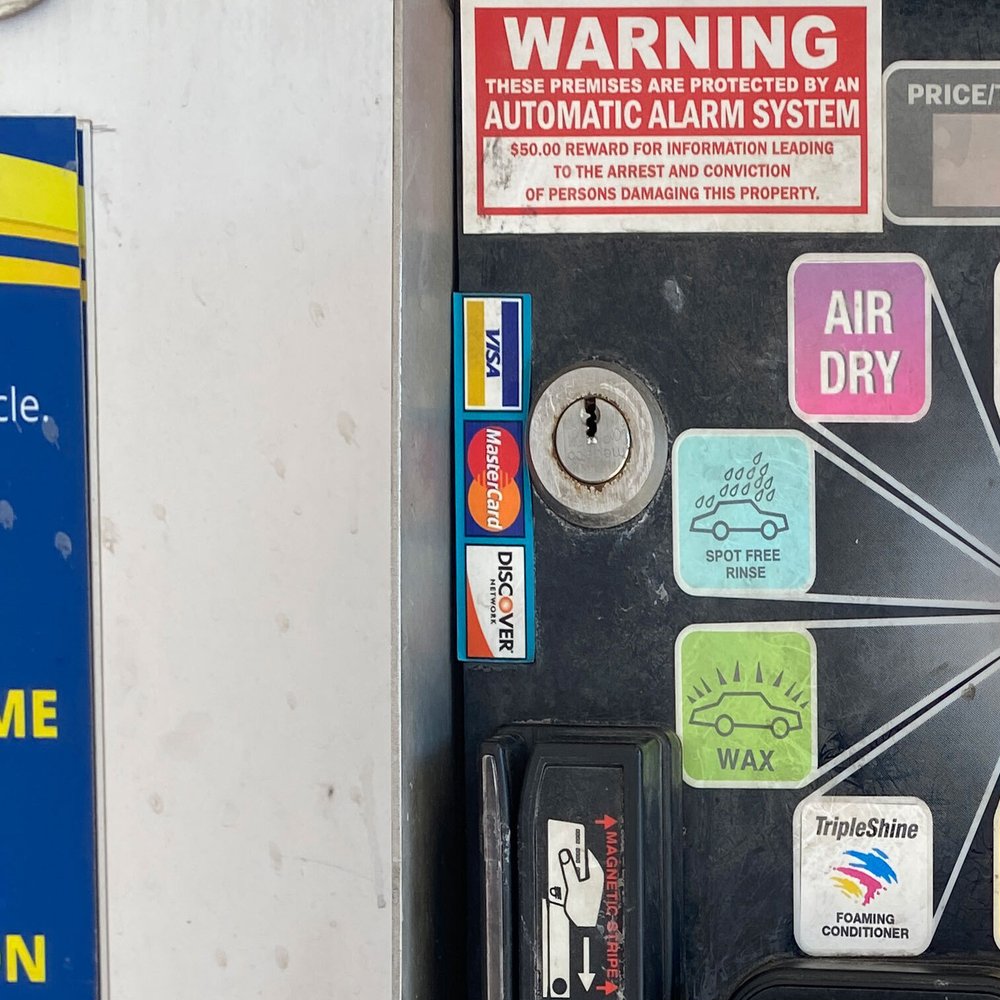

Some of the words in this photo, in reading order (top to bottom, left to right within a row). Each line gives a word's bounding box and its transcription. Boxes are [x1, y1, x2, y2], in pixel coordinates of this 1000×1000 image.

[504, 15, 838, 70] WARNING
[485, 78, 547, 94] THESE
[550, 78, 642, 94] PREMISES
[648, 78, 684, 94] ARE
[690, 77, 799, 93] PROTECTED
[804, 77, 828, 93] BY
[834, 77, 860, 93] AN
[484, 99, 642, 130] AUTOMATIC
[648, 99, 744, 129] ALARM
[752, 99, 860, 129] SYSTEM
[510, 142, 561, 157] $50.00
[565, 142, 629, 156] REWARD
[633, 142, 663, 156] FOR
[666, 142, 767, 156] INFORMATION
[771, 141, 834, 156] LEADING
[554, 165, 572, 178] TO
[576, 165, 603, 178] THE
[607, 165, 665, 178] ARREST
[669, 165, 699, 178] AND
[703, 164, 791, 178] CONVICTION
[526, 187, 545, 201] OF
[549, 186, 617, 201] PERSONS
[620, 186, 700, 200] DAMAGING
[703, 186, 736, 200] THIS
[740, 186, 820, 200] PROPERTY.
[824, 291, 893, 335] AIR
[485, 328, 501, 379] VISA
[820, 350, 902, 395] DRY
[0, 386, 49, 422] le.
[485, 427, 504, 531] MasterCard
[706, 549, 742, 563] SPOT
[745, 549, 780, 562] FREE
[726, 567, 766, 579] RINSE
[497, 551, 514, 653] DISCOVER
[717, 748, 775, 772] WAX
[815, 815, 919, 840] TripleShine
[605, 831, 618, 916] MAGNETIC
[822, 926, 910, 939] CONDITIONER
[836, 912, 895, 925] FOAMING
[606, 921, 619, 978] STRIPE
